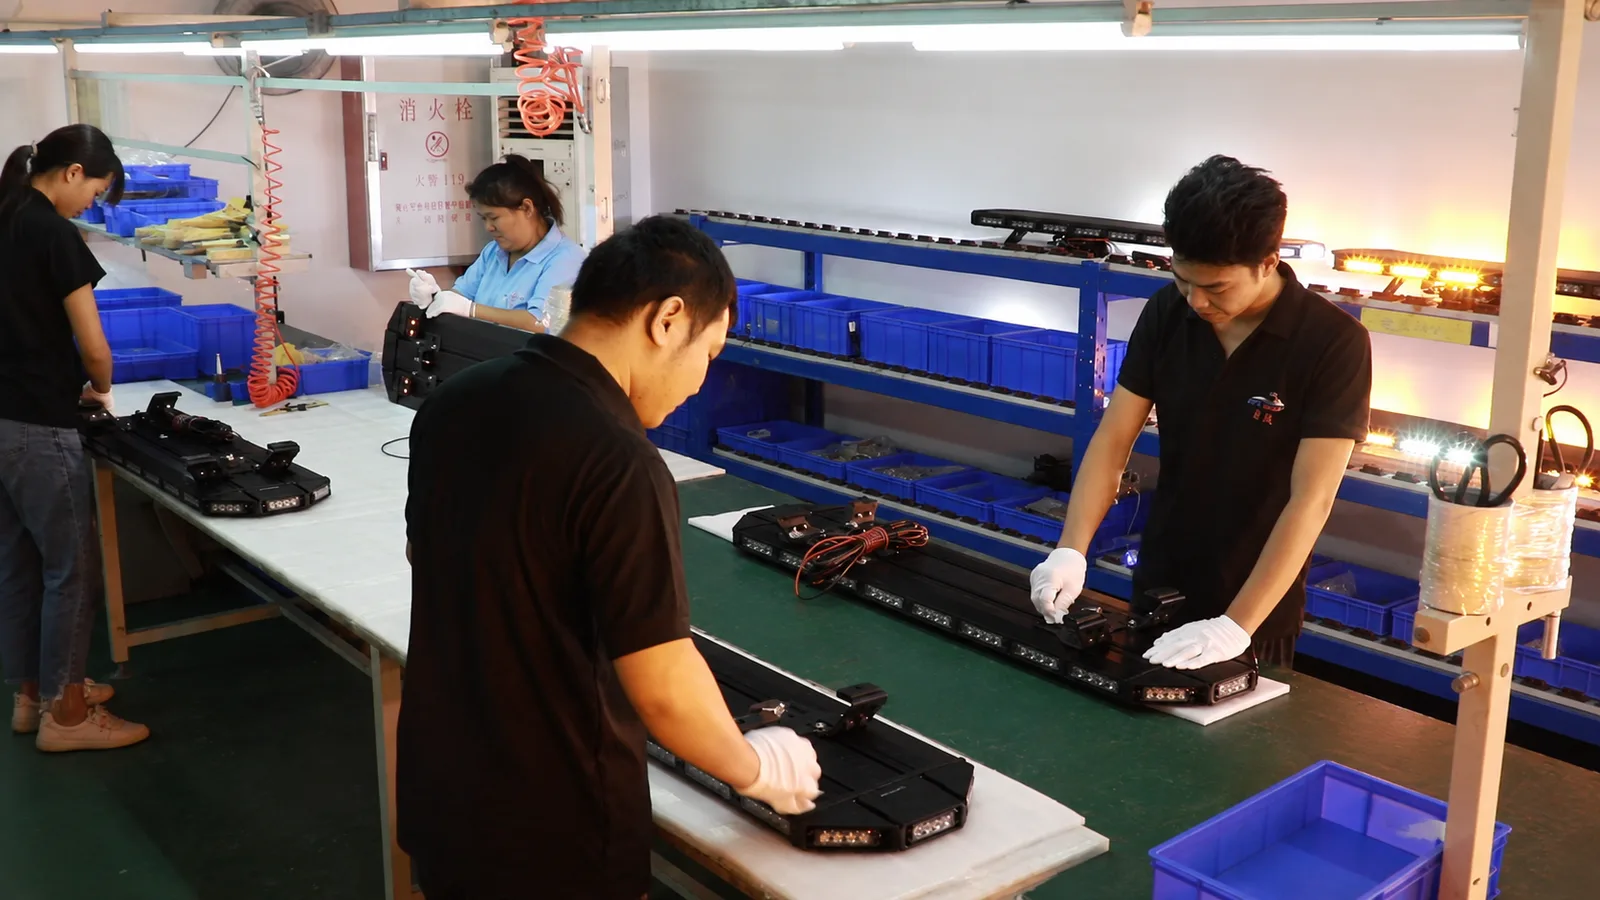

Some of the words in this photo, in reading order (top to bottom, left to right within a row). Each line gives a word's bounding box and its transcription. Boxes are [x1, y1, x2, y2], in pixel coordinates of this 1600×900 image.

[399, 98, 473, 122] 消火栓
[444, 173, 465, 186] 119
